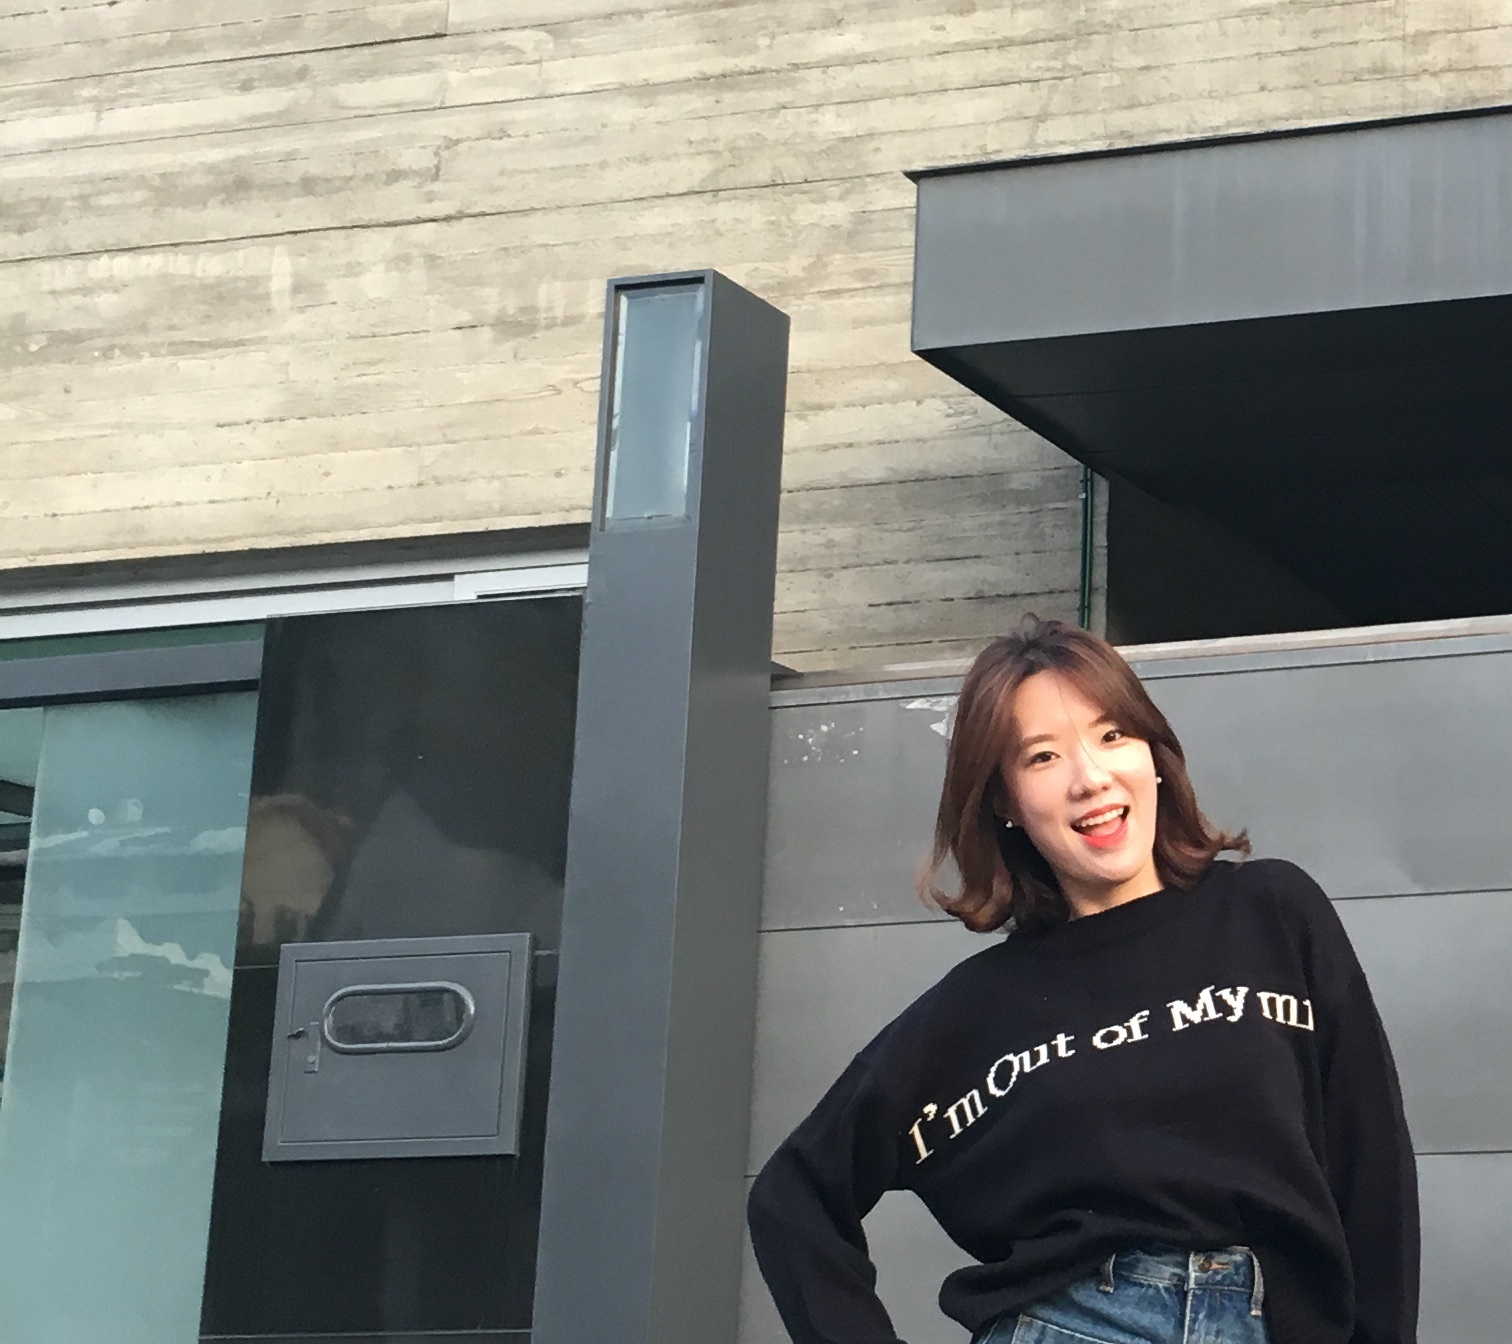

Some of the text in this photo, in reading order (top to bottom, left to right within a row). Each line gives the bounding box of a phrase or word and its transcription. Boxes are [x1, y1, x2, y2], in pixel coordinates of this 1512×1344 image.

[908, 1088, 988, 1165] I'm
[986, 1032, 1076, 1097] Out
[1093, 1010, 1150, 1050] of
[1166, 984, 1250, 1032] My
